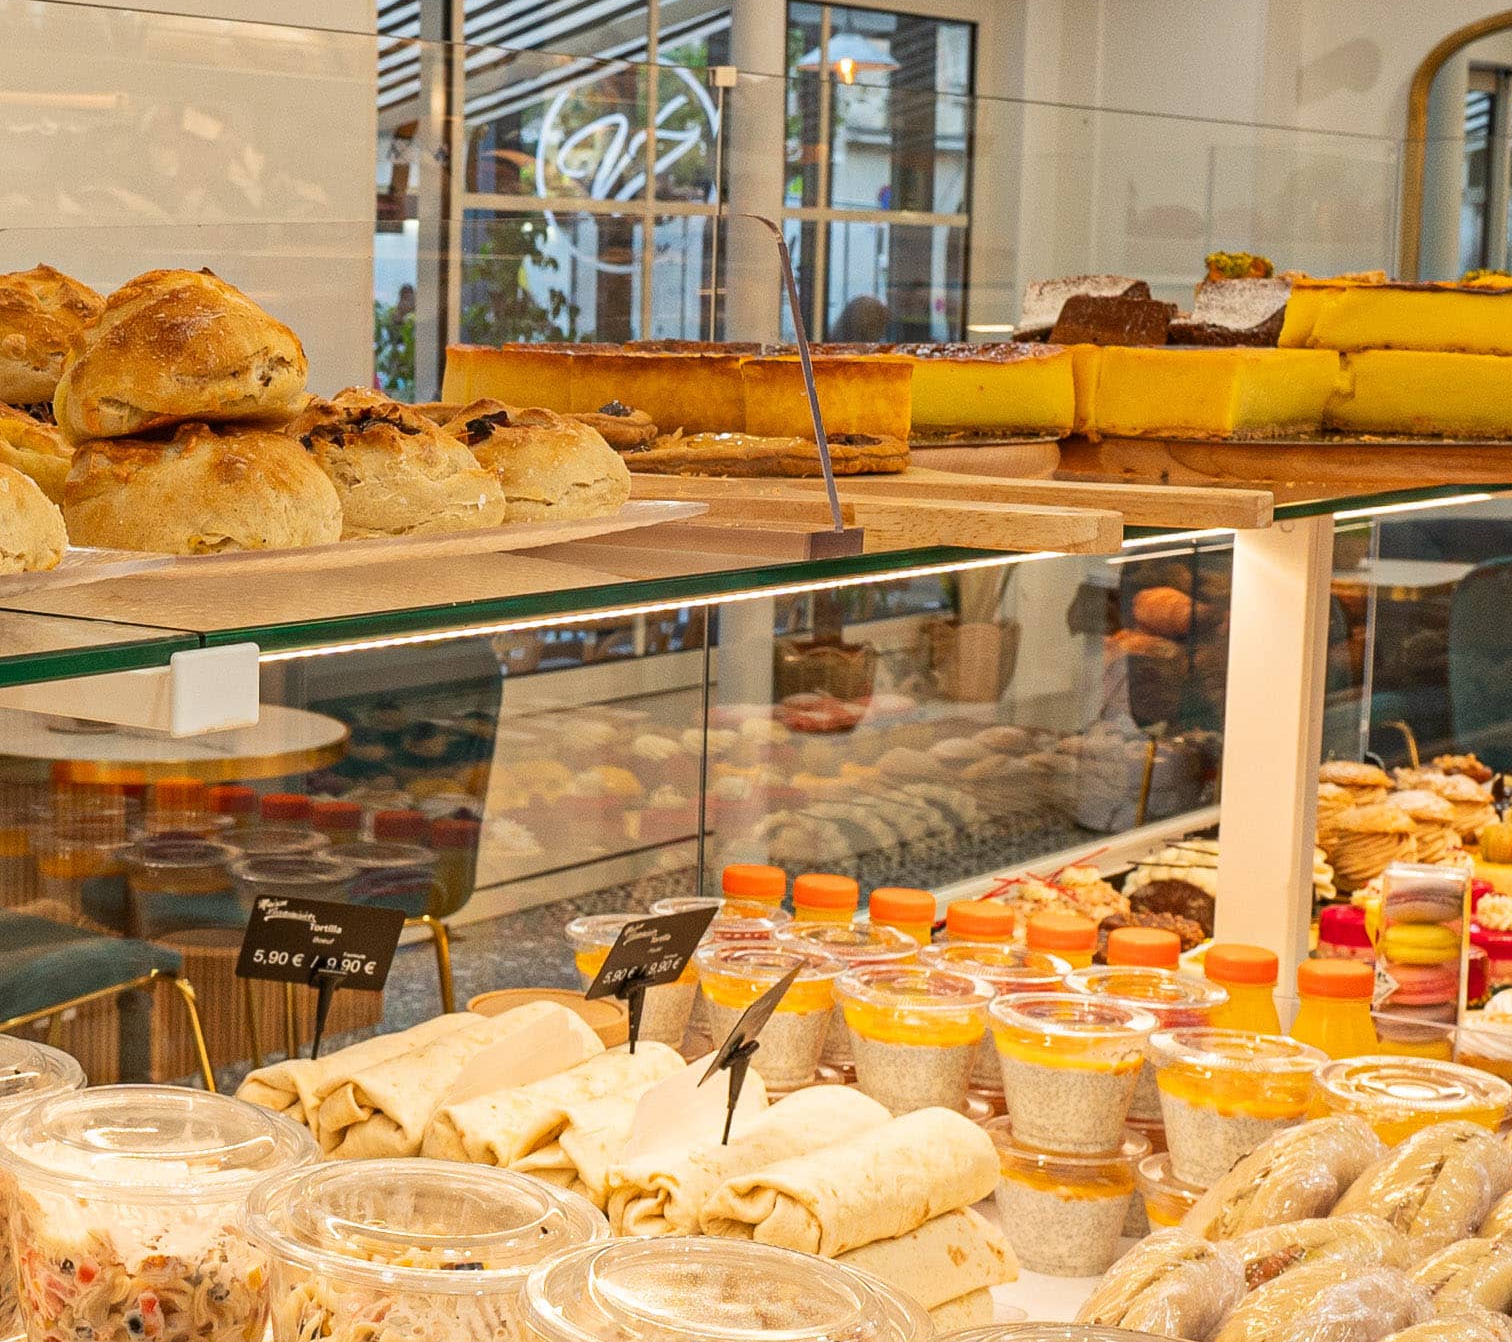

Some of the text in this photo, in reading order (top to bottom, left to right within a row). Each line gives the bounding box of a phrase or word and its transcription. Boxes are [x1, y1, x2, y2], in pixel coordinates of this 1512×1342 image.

[309, 923, 342, 934] Tortilla
[253, 949, 289, 966] 5,90
[292, 953, 305, 967] €
[364, 960, 377, 975] €
